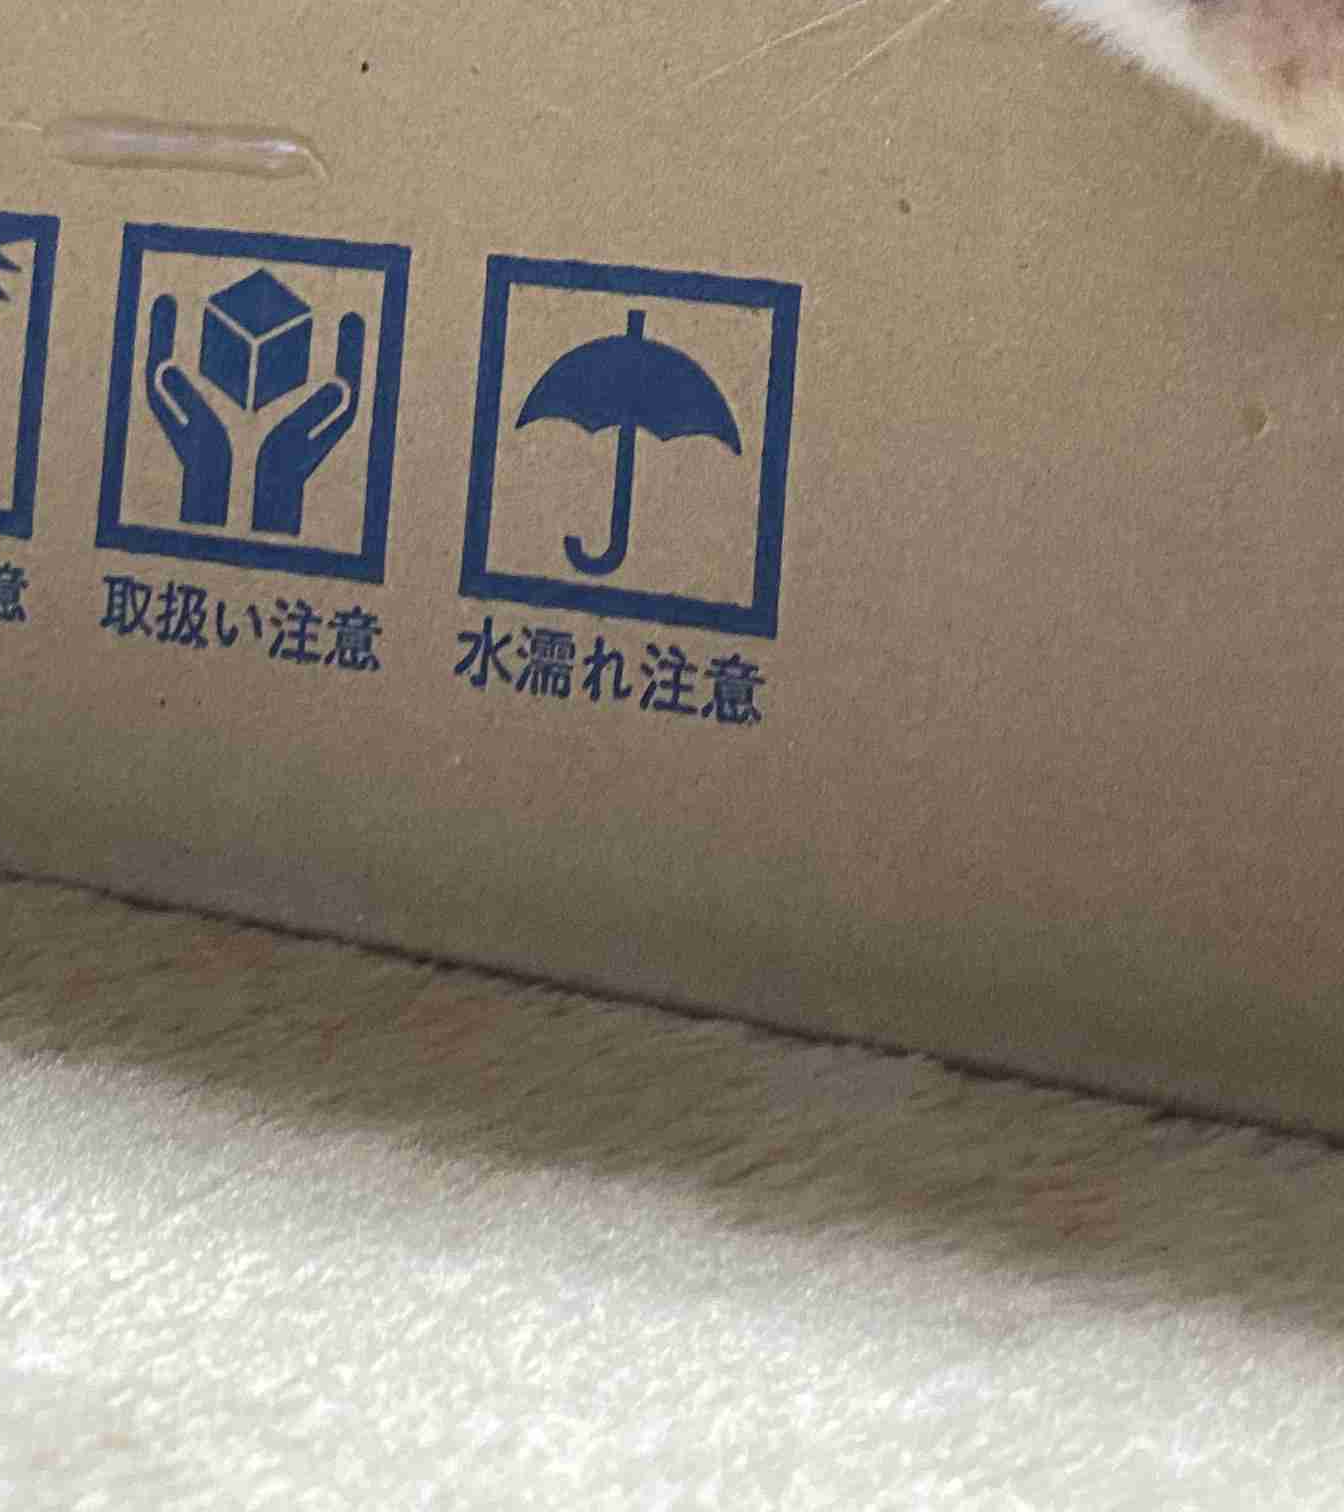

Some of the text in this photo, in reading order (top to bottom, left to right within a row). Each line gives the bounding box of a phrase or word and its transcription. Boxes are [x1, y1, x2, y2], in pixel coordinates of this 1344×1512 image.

[99, 575, 383, 671] 取扱い注意
[453, 615, 766, 725] 水濡れ注意
